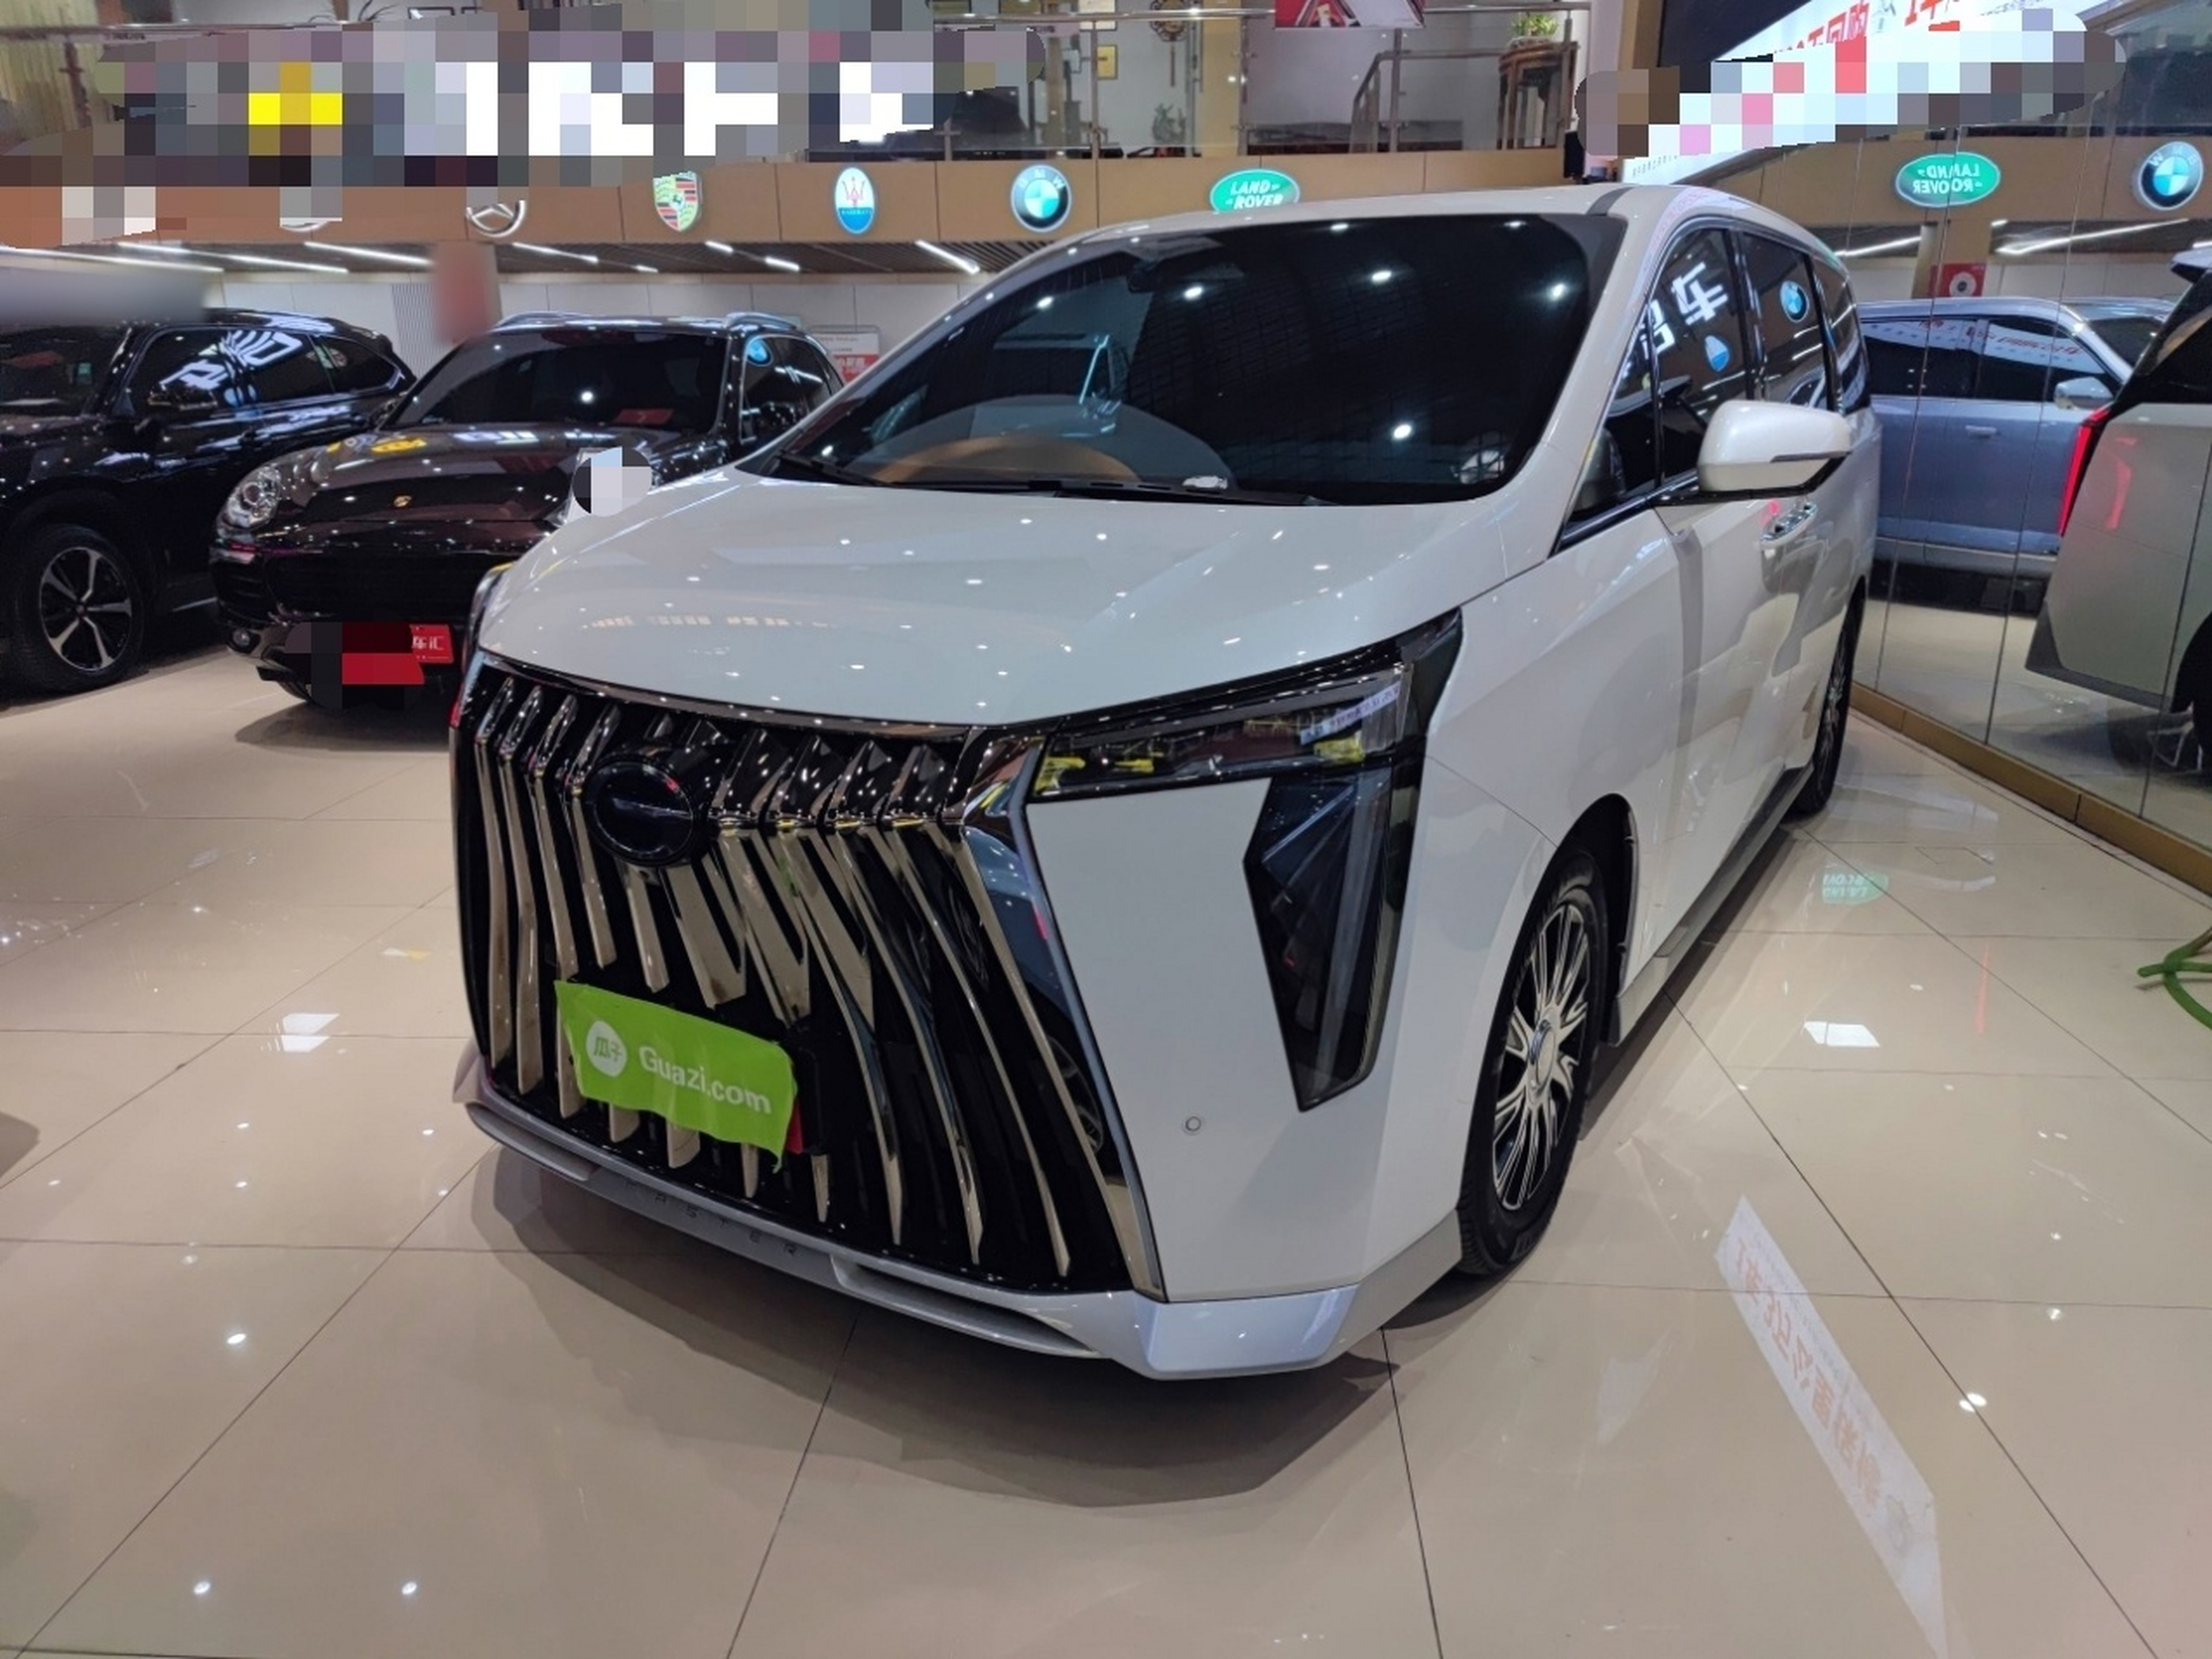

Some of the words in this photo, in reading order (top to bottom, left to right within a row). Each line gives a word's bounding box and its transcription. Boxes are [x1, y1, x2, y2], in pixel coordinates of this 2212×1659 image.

[1230, 179, 1271, 195] LAND
[1233, 193, 1283, 210] ROVER
[593, 1036, 622, 1062] 瓜子
[639, 1046, 772, 1115] Guazi.com
